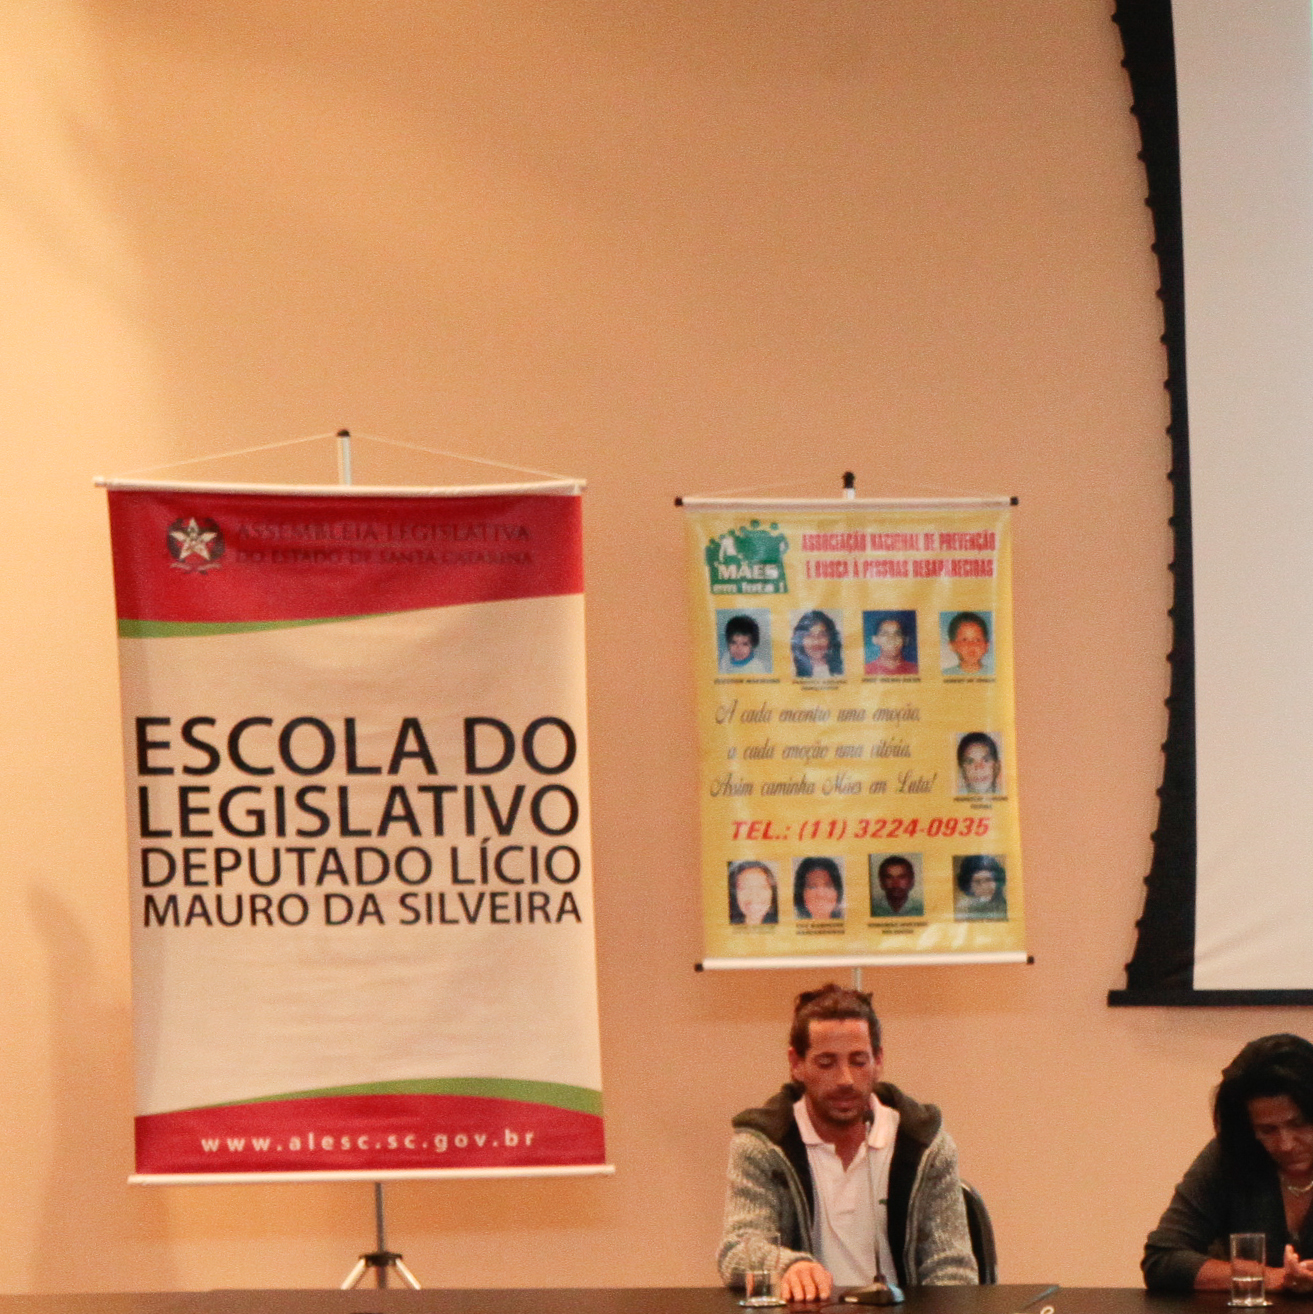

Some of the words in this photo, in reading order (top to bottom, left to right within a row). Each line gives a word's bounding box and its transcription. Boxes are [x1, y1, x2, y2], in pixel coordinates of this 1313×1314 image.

[923, 532, 937, 551] DE
[939, 529, 995, 554] PREVENÇÃO
[718, 561, 778, 580] MÃES
[740, 701, 771, 724] cada
[135, 716, 438, 776] ESCOLA
[464, 716, 577, 776] DO
[743, 738, 774, 760] cada
[138, 784, 580, 838] LEGISLATIVO
[732, 821, 791, 840] TEL.:
[798, 819, 848, 840] (11)
[853, 817, 990, 838] 3224-0935
[140, 846, 432, 888] DEPUTADO
[451, 837, 581, 885] LÍCIO
[143, 894, 309, 928] MAURO
[324, 893, 385, 926] DA
[400, 891, 582, 924] SILVEIRA
[201, 1130, 536, 1153] www.alesc.sc.gov.br
